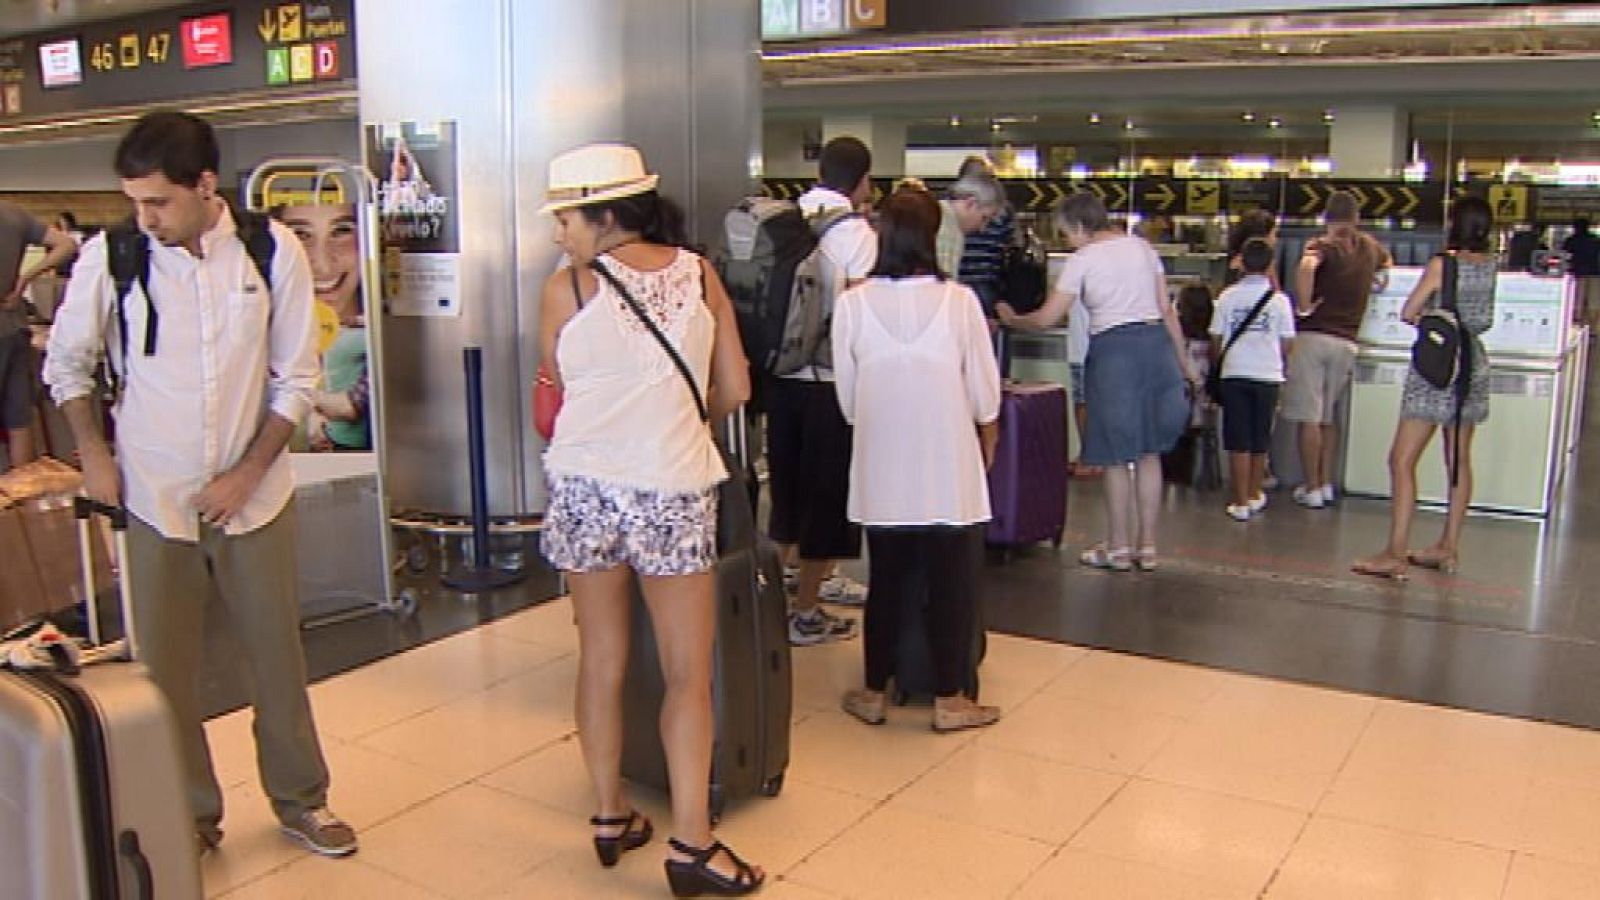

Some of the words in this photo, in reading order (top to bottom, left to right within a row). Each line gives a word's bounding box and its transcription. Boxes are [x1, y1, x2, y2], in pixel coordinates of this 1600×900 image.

[767, 0, 788, 25] A
[812, 0, 833, 22] B
[855, 0, 876, 20] C
[91, 43, 114, 71] 46
[147, 33, 170, 63] 47
[272, 52, 285, 74] A
[320, 48, 334, 73] D
